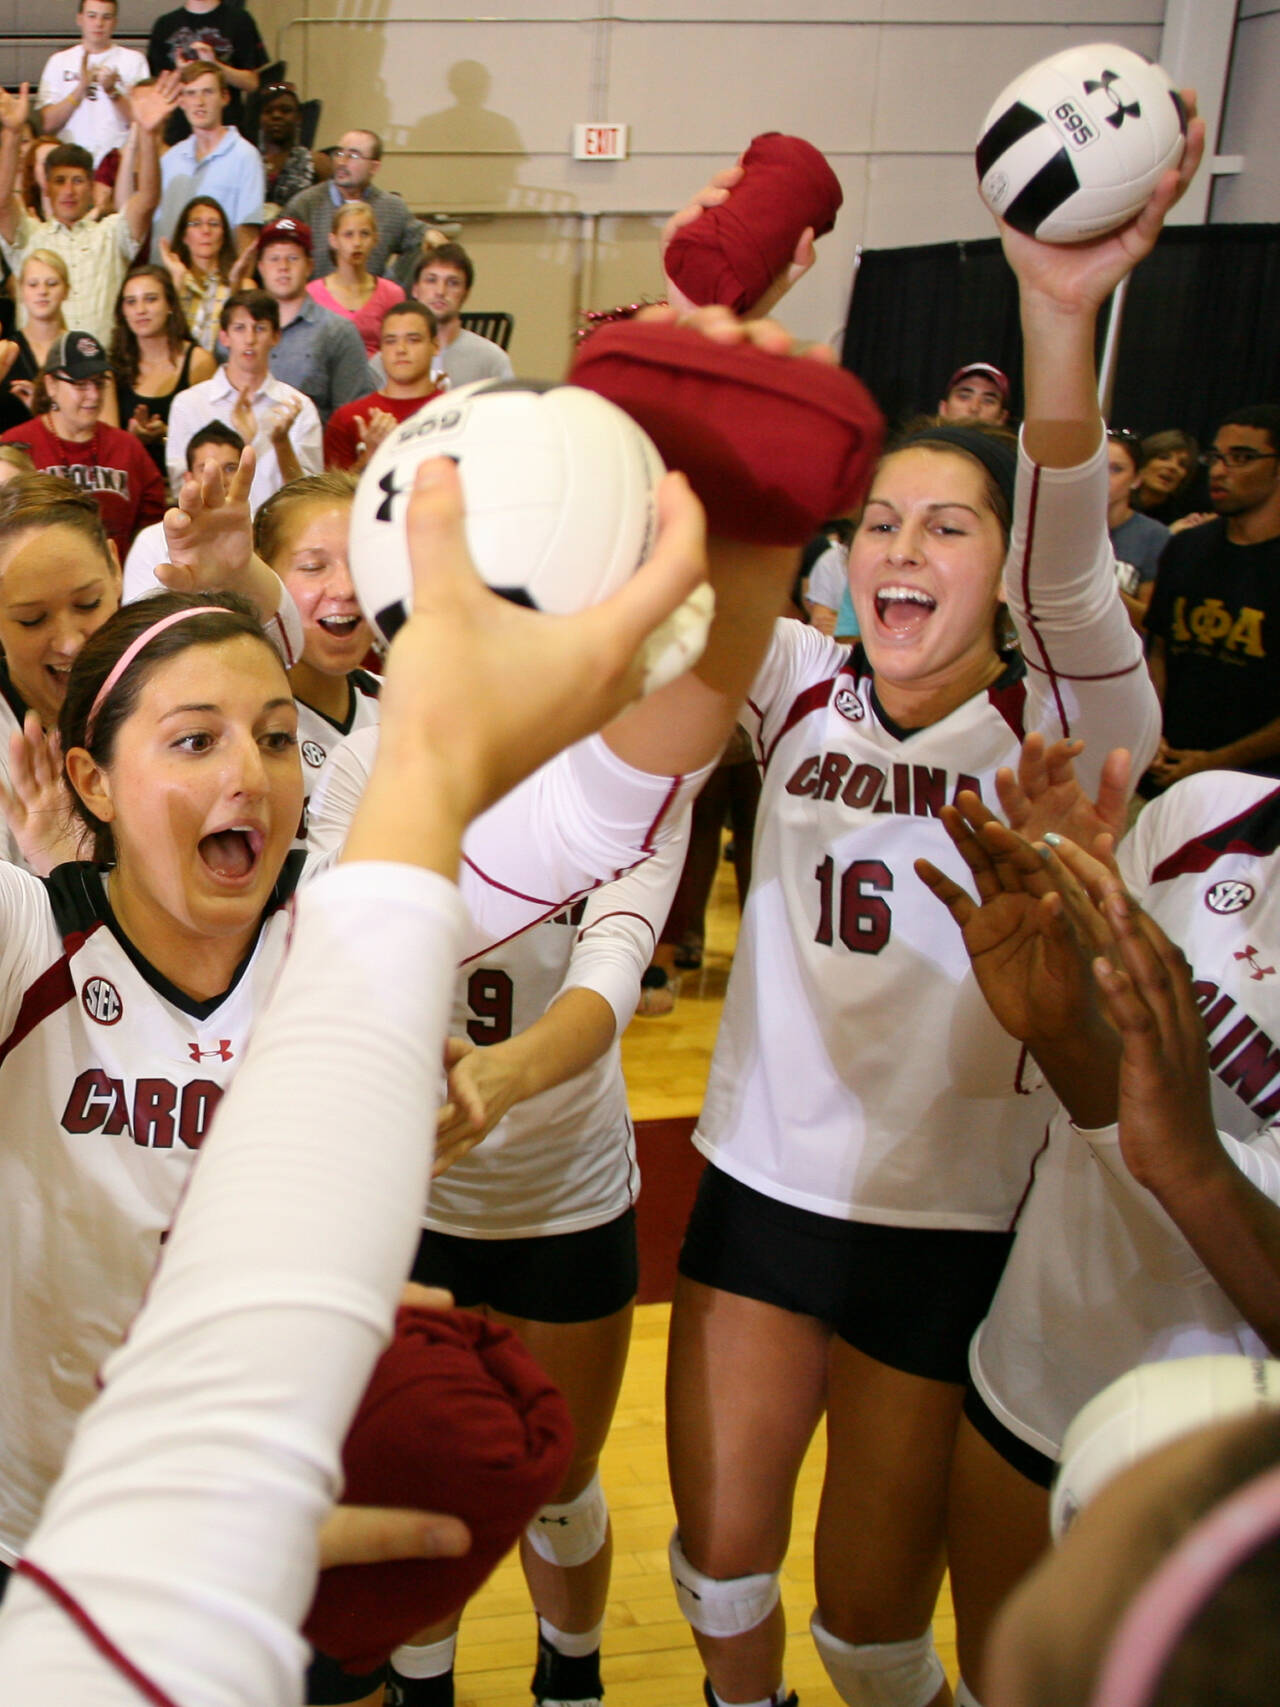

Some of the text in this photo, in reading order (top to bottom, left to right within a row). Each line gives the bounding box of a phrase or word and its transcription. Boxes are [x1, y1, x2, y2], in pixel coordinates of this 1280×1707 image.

[586, 128, 618, 155] EXIT
[1055, 102, 1093, 145] 695
[814, 855, 893, 955] 16
[1207, 882, 1253, 913] SEC
[85, 979, 122, 1022] SEC
[467, 968, 513, 1046] 9
